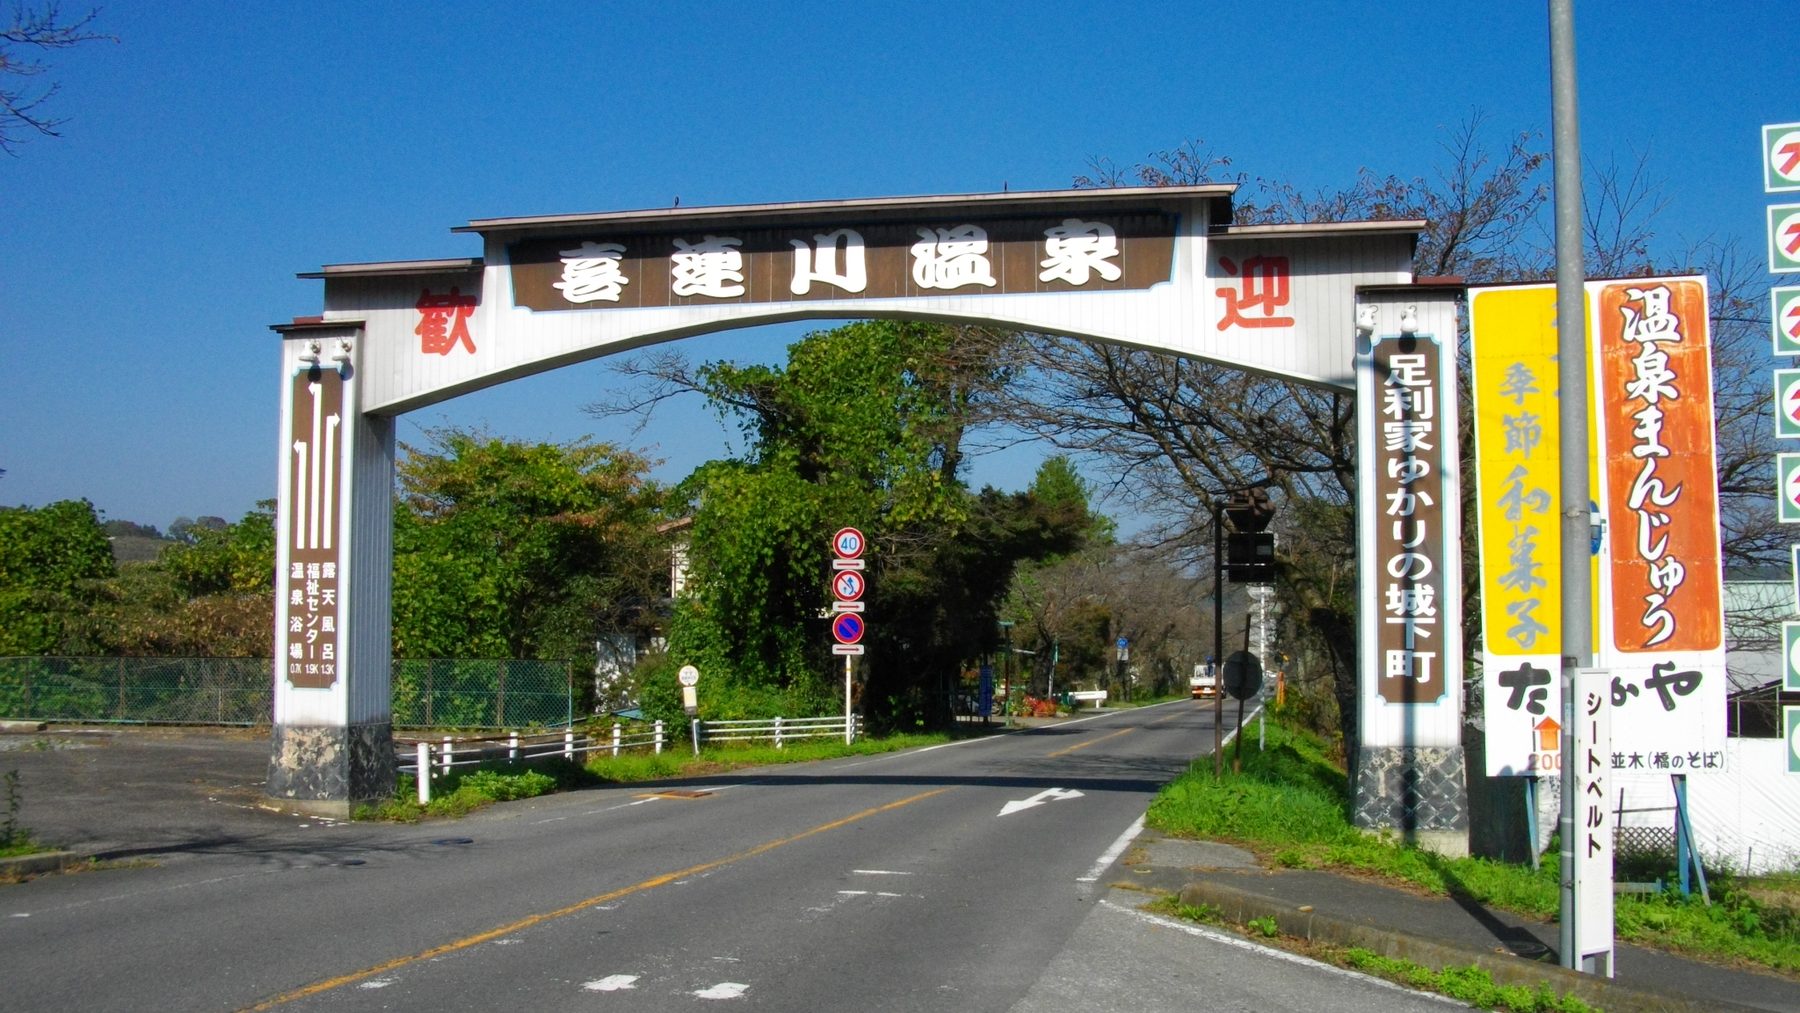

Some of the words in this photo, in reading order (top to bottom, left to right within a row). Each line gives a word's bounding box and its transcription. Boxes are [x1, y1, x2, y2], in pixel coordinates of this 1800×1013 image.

[414, 287, 477, 356] 歓
[1215, 256, 1295, 331] 迎
[1497, 362, 1552, 649] 季節和菓子
[1620, 285, 1685, 649] 温泉まんじゅう
[841, 537, 857, 550] 40
[1383, 354, 1436, 684] 足利家ゆかりの城下町
[290, 562, 304, 659] 温泉浴場
[306, 562, 320, 659] 福祉センター
[322, 562, 336, 660] 露天風呂
[1587, 691, 1604, 858] シートベルト
